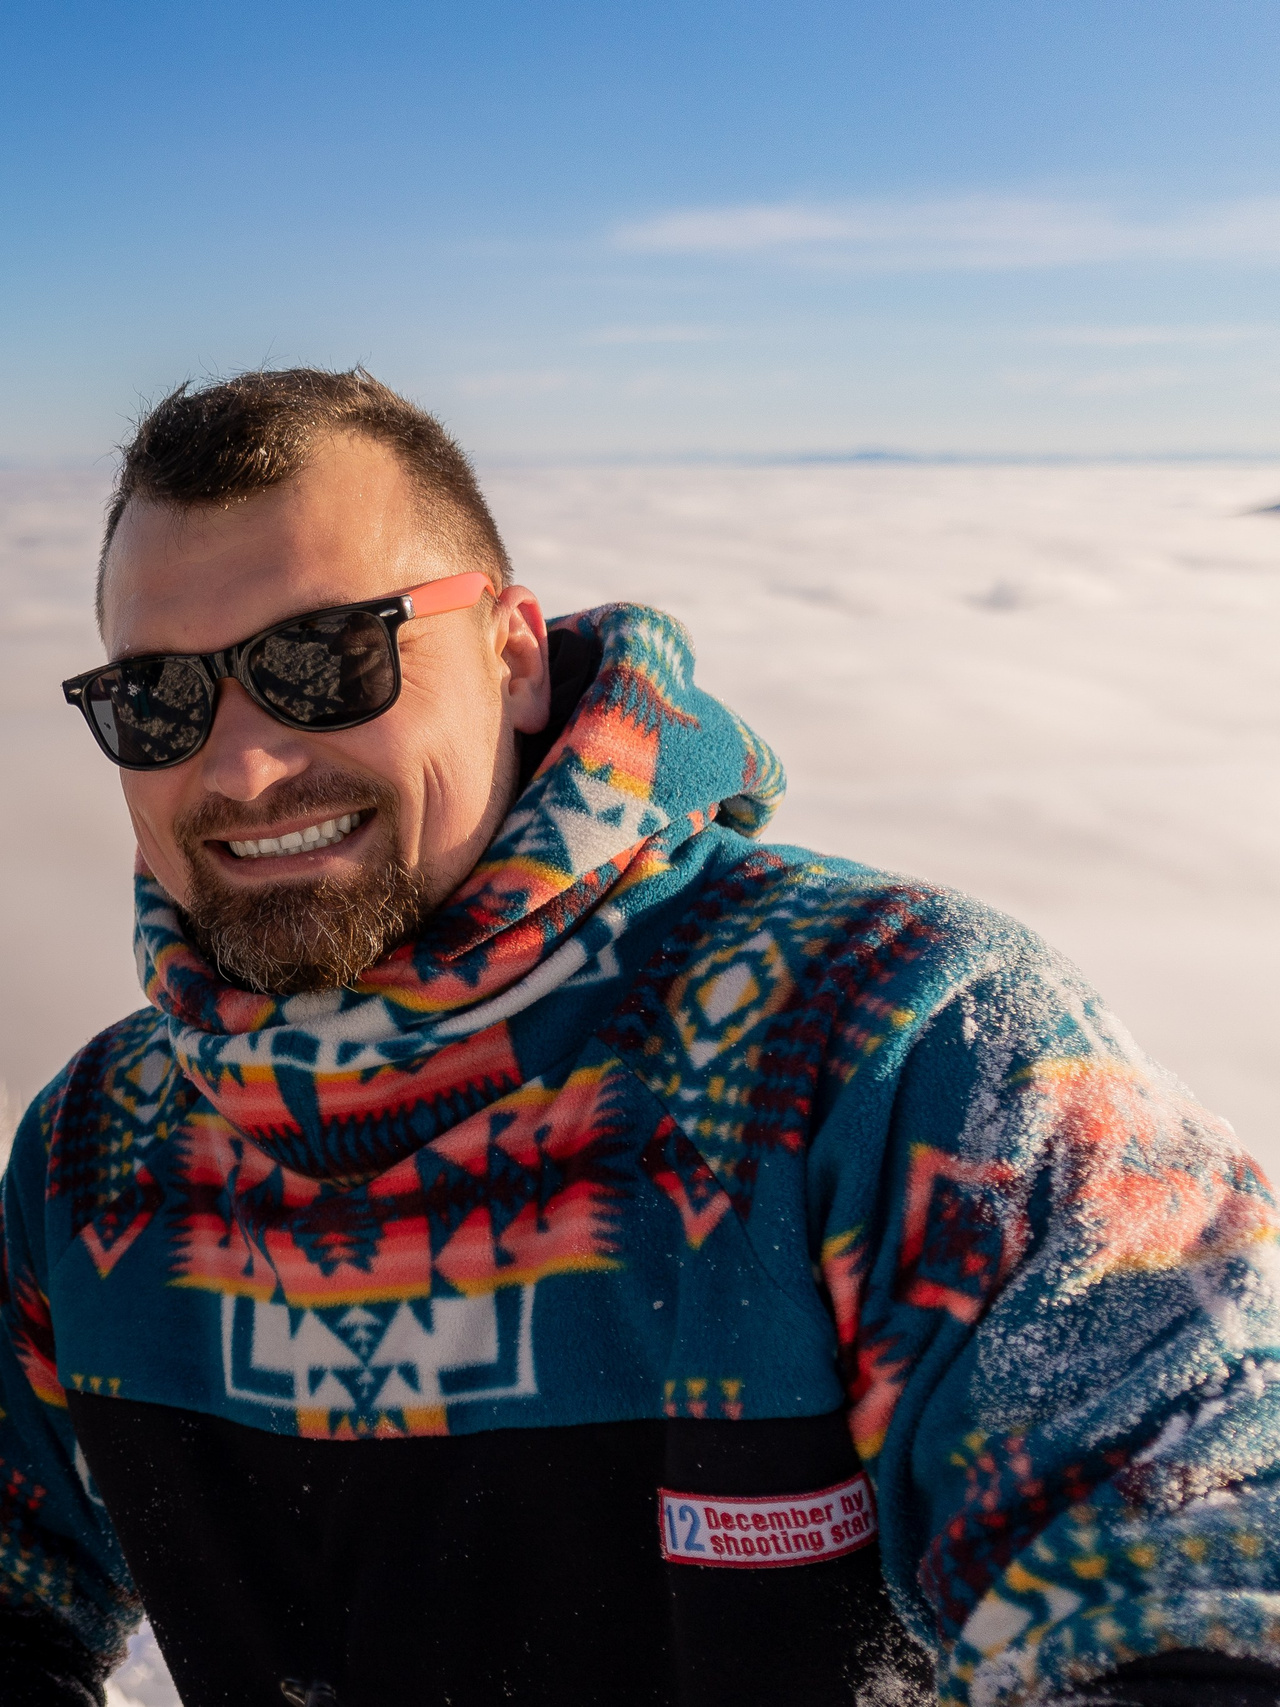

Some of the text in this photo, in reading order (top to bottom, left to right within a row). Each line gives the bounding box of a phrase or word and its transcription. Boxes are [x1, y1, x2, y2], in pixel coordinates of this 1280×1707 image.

[665, 1504, 705, 1552] 12
[703, 1488, 865, 1532] December by
[710, 1511, 871, 1557] shooting star
